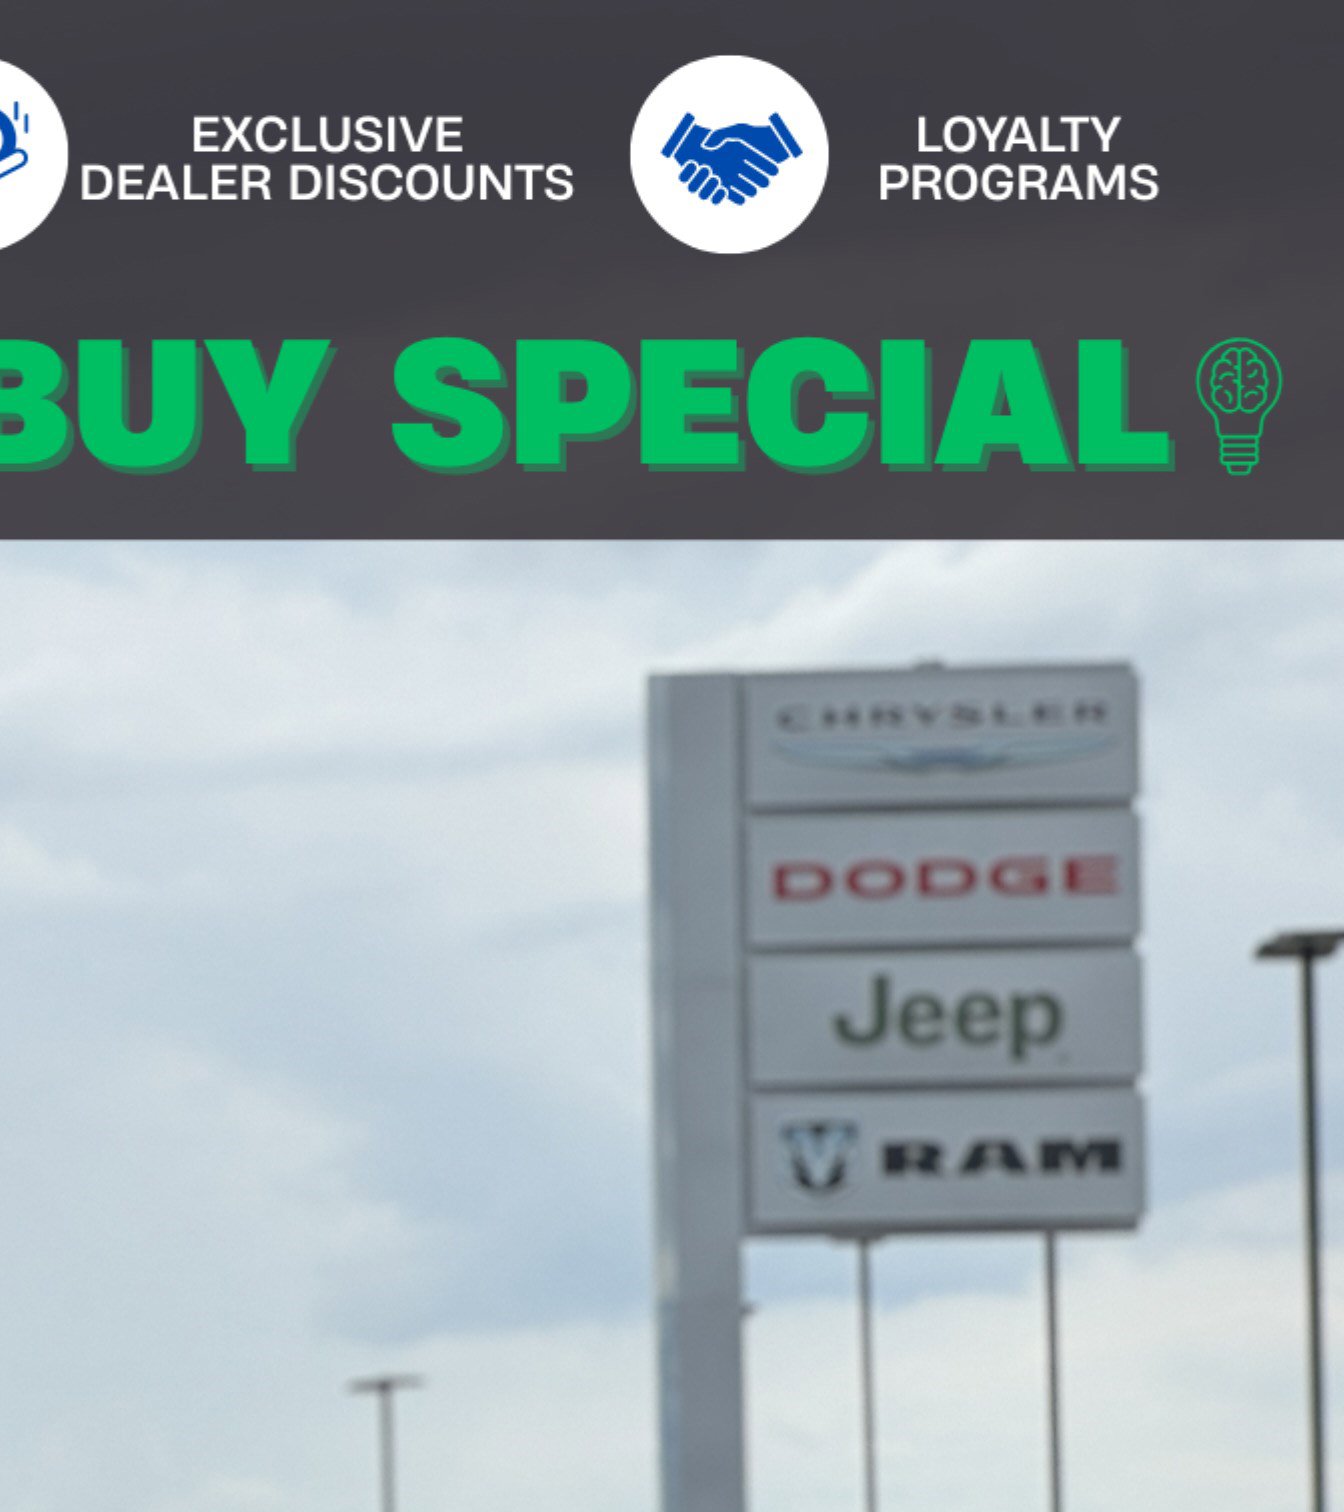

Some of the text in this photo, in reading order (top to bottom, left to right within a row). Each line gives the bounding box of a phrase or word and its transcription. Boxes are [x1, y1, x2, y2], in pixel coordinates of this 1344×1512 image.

[775, 700, 1109, 732] CHRYSLER
[771, 854, 1120, 902] DODGE
[831, 972, 1065, 1061] Jeep
[881, 1137, 1124, 1178] RAM
